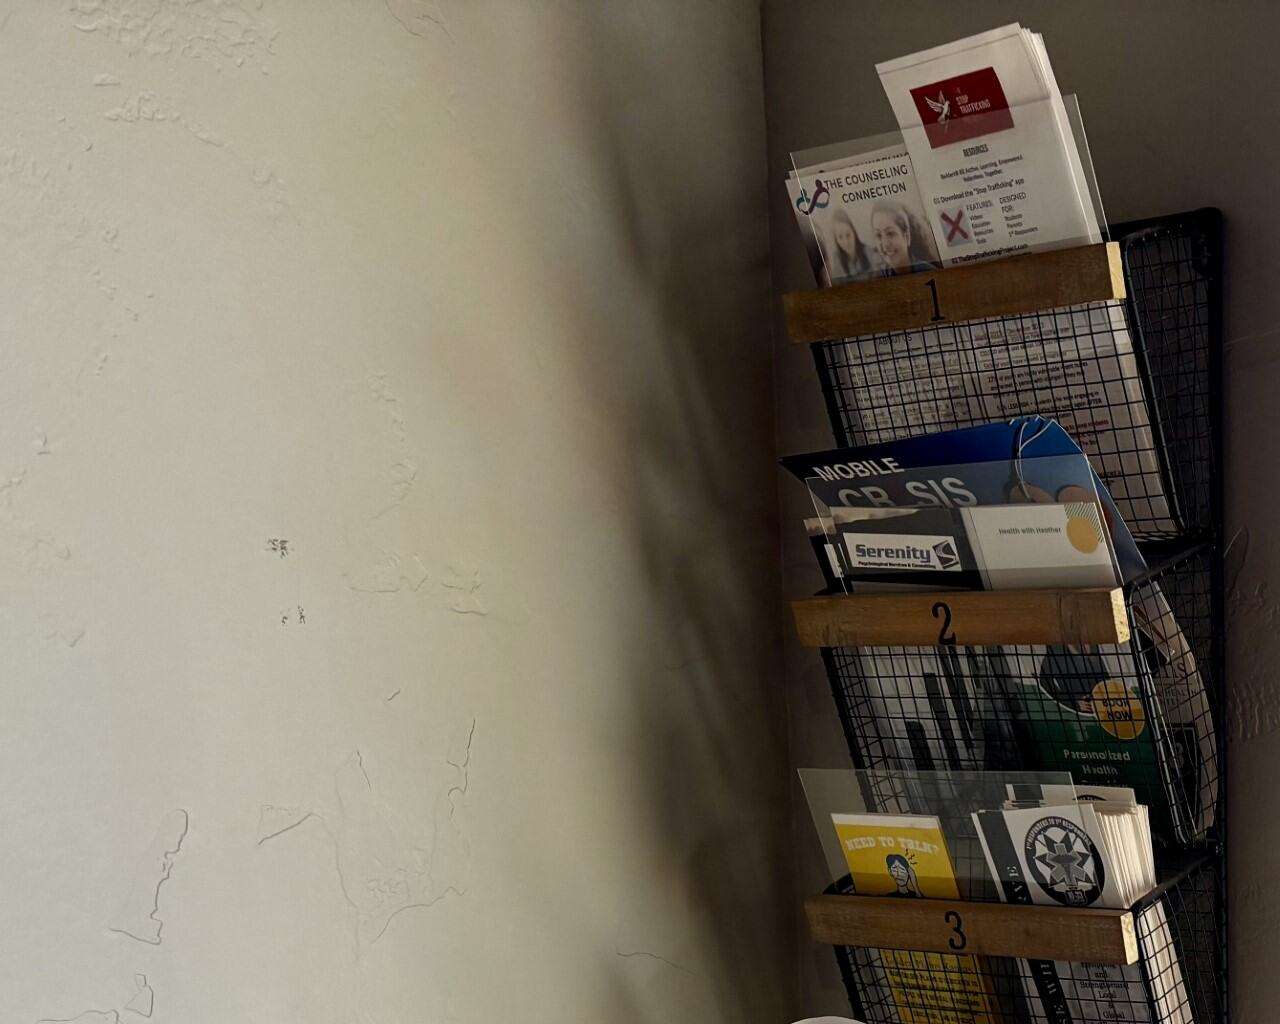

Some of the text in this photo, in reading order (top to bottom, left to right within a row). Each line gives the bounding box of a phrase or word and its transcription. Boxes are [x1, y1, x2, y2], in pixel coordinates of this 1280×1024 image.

[823, 164, 908, 190] THE COUNSELING
[841, 181, 907, 204] CONNECTION
[925, 278, 947, 321] 1
[812, 457, 906, 482] MOBILE
[837, 476, 979, 508] CRSIS
[854, 543, 932, 564] Serenity
[931, 601, 956, 645] 2
[845, 837, 878, 850] NEED
[880, 836, 895, 849] TO
[944, 910, 967, 950] 3
